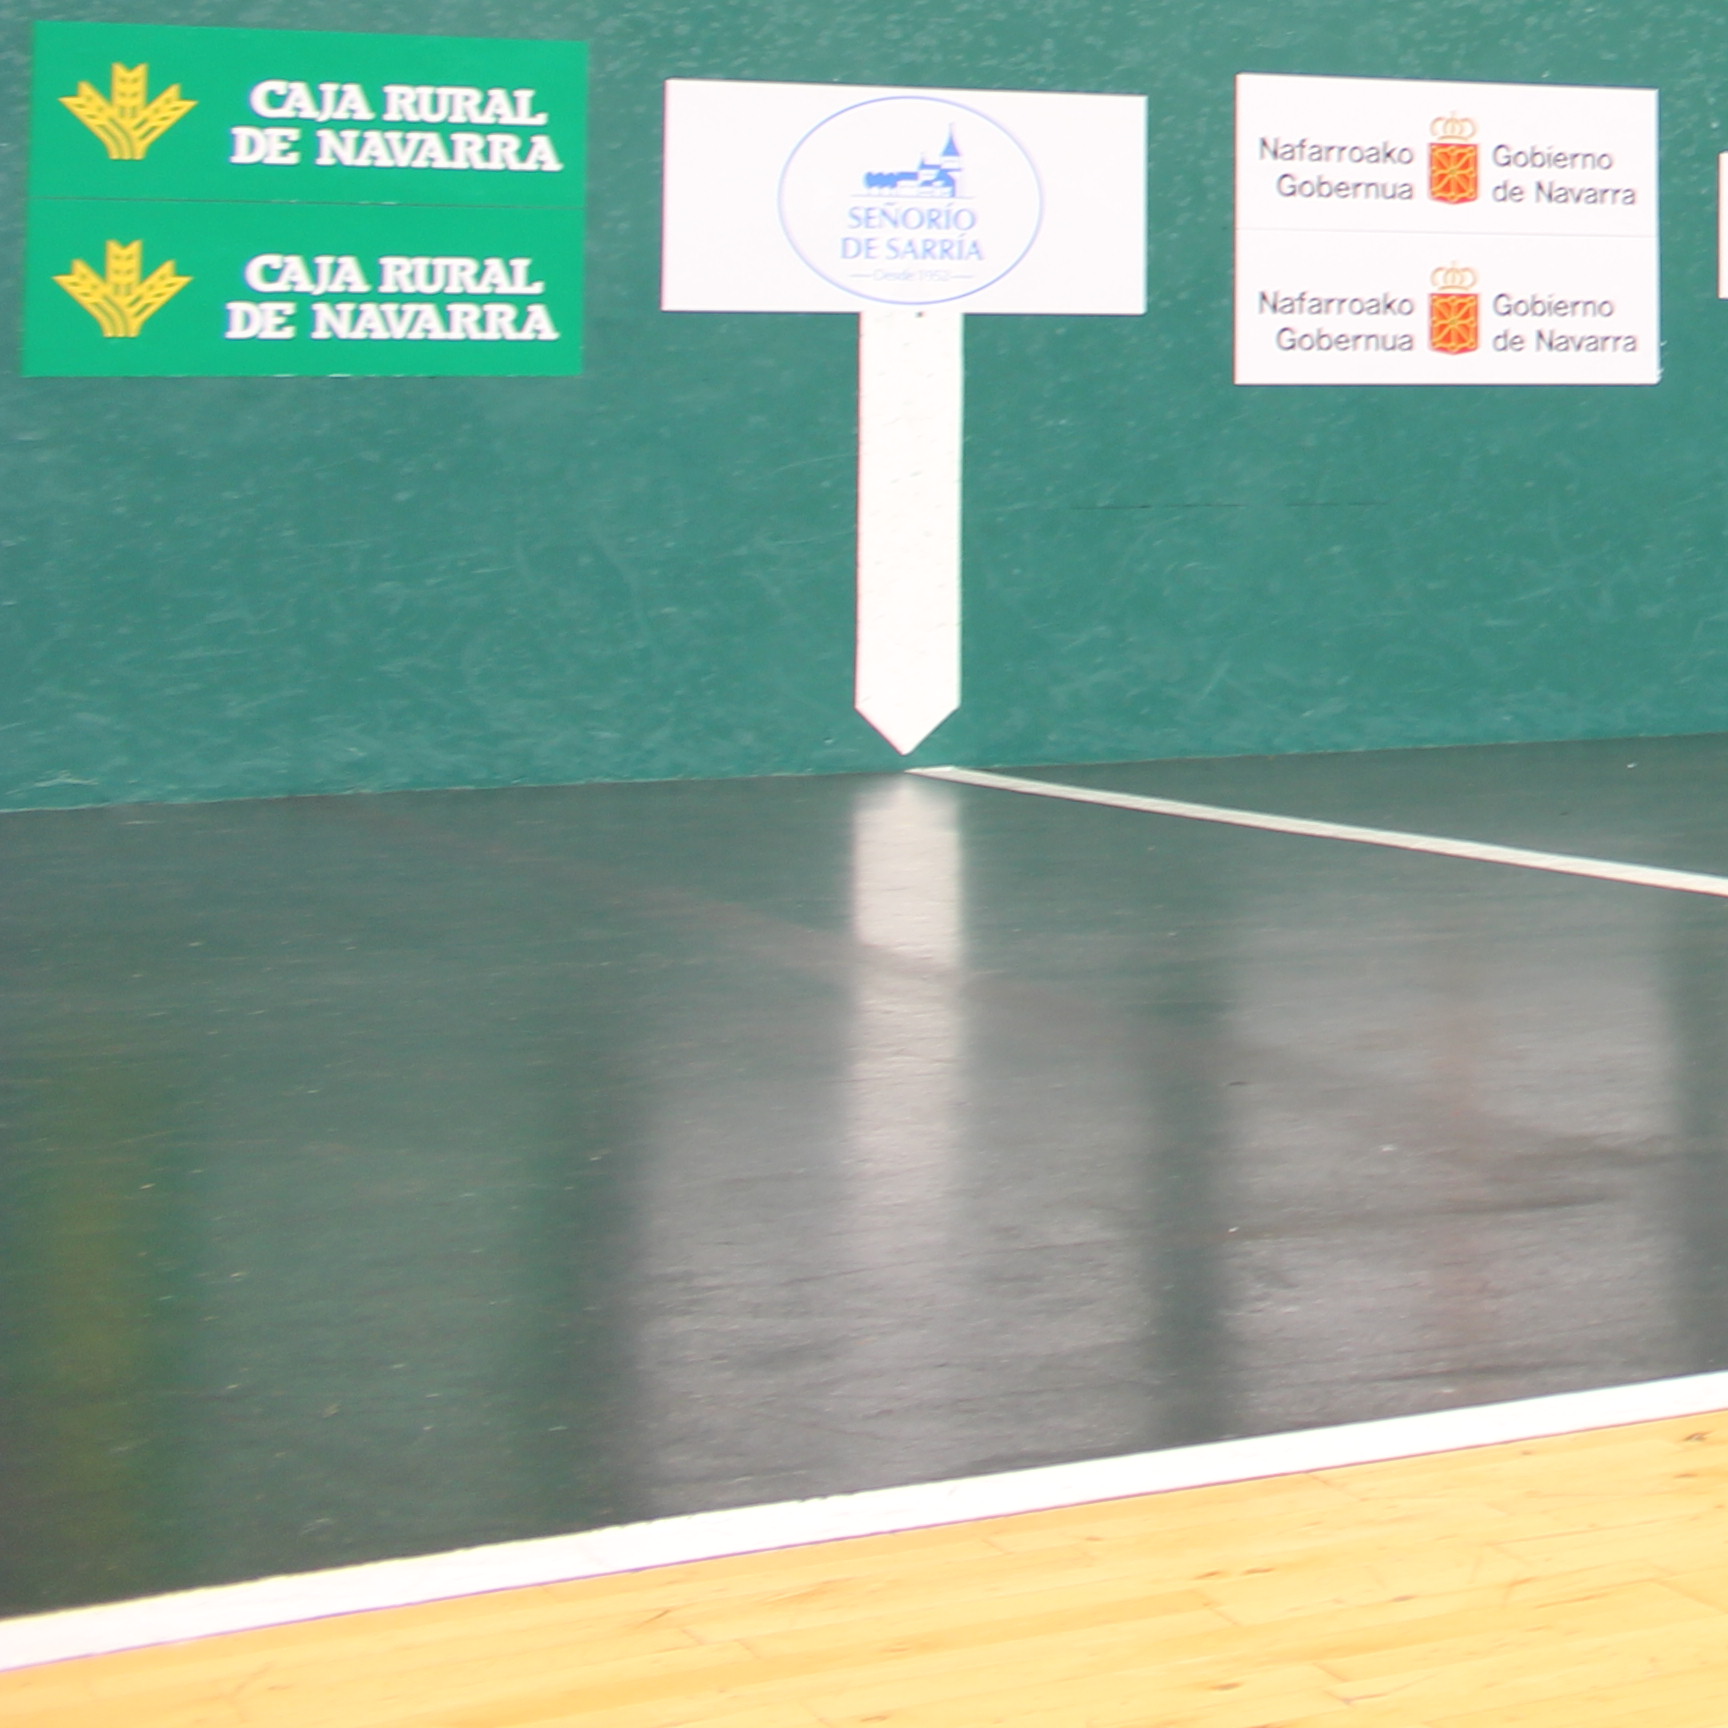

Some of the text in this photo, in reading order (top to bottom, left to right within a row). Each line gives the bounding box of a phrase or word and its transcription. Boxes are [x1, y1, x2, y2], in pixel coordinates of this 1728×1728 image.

[251, 79, 548, 125] CAJA RURAL
[229, 126, 564, 171] DE NAVARRA
[1258, 137, 1415, 165] Nafarroako
[1492, 143, 1613, 170] Gobierno
[1276, 174, 1414, 200] Gobernua
[1492, 180, 1636, 205] de Navarra
[848, 202, 976, 231] SEÑORÍO
[840, 233, 984, 260] DE SARRÍA
[245, 253, 545, 295] CAJA RURAL
[1258, 291, 1415, 316] Nafarroako
[1492, 293, 1614, 318] Gobierno
[225, 301, 560, 341] DE NAVARRA
[1276, 327, 1414, 353] Gobernua
[1492, 329, 1637, 353] de Navarra
